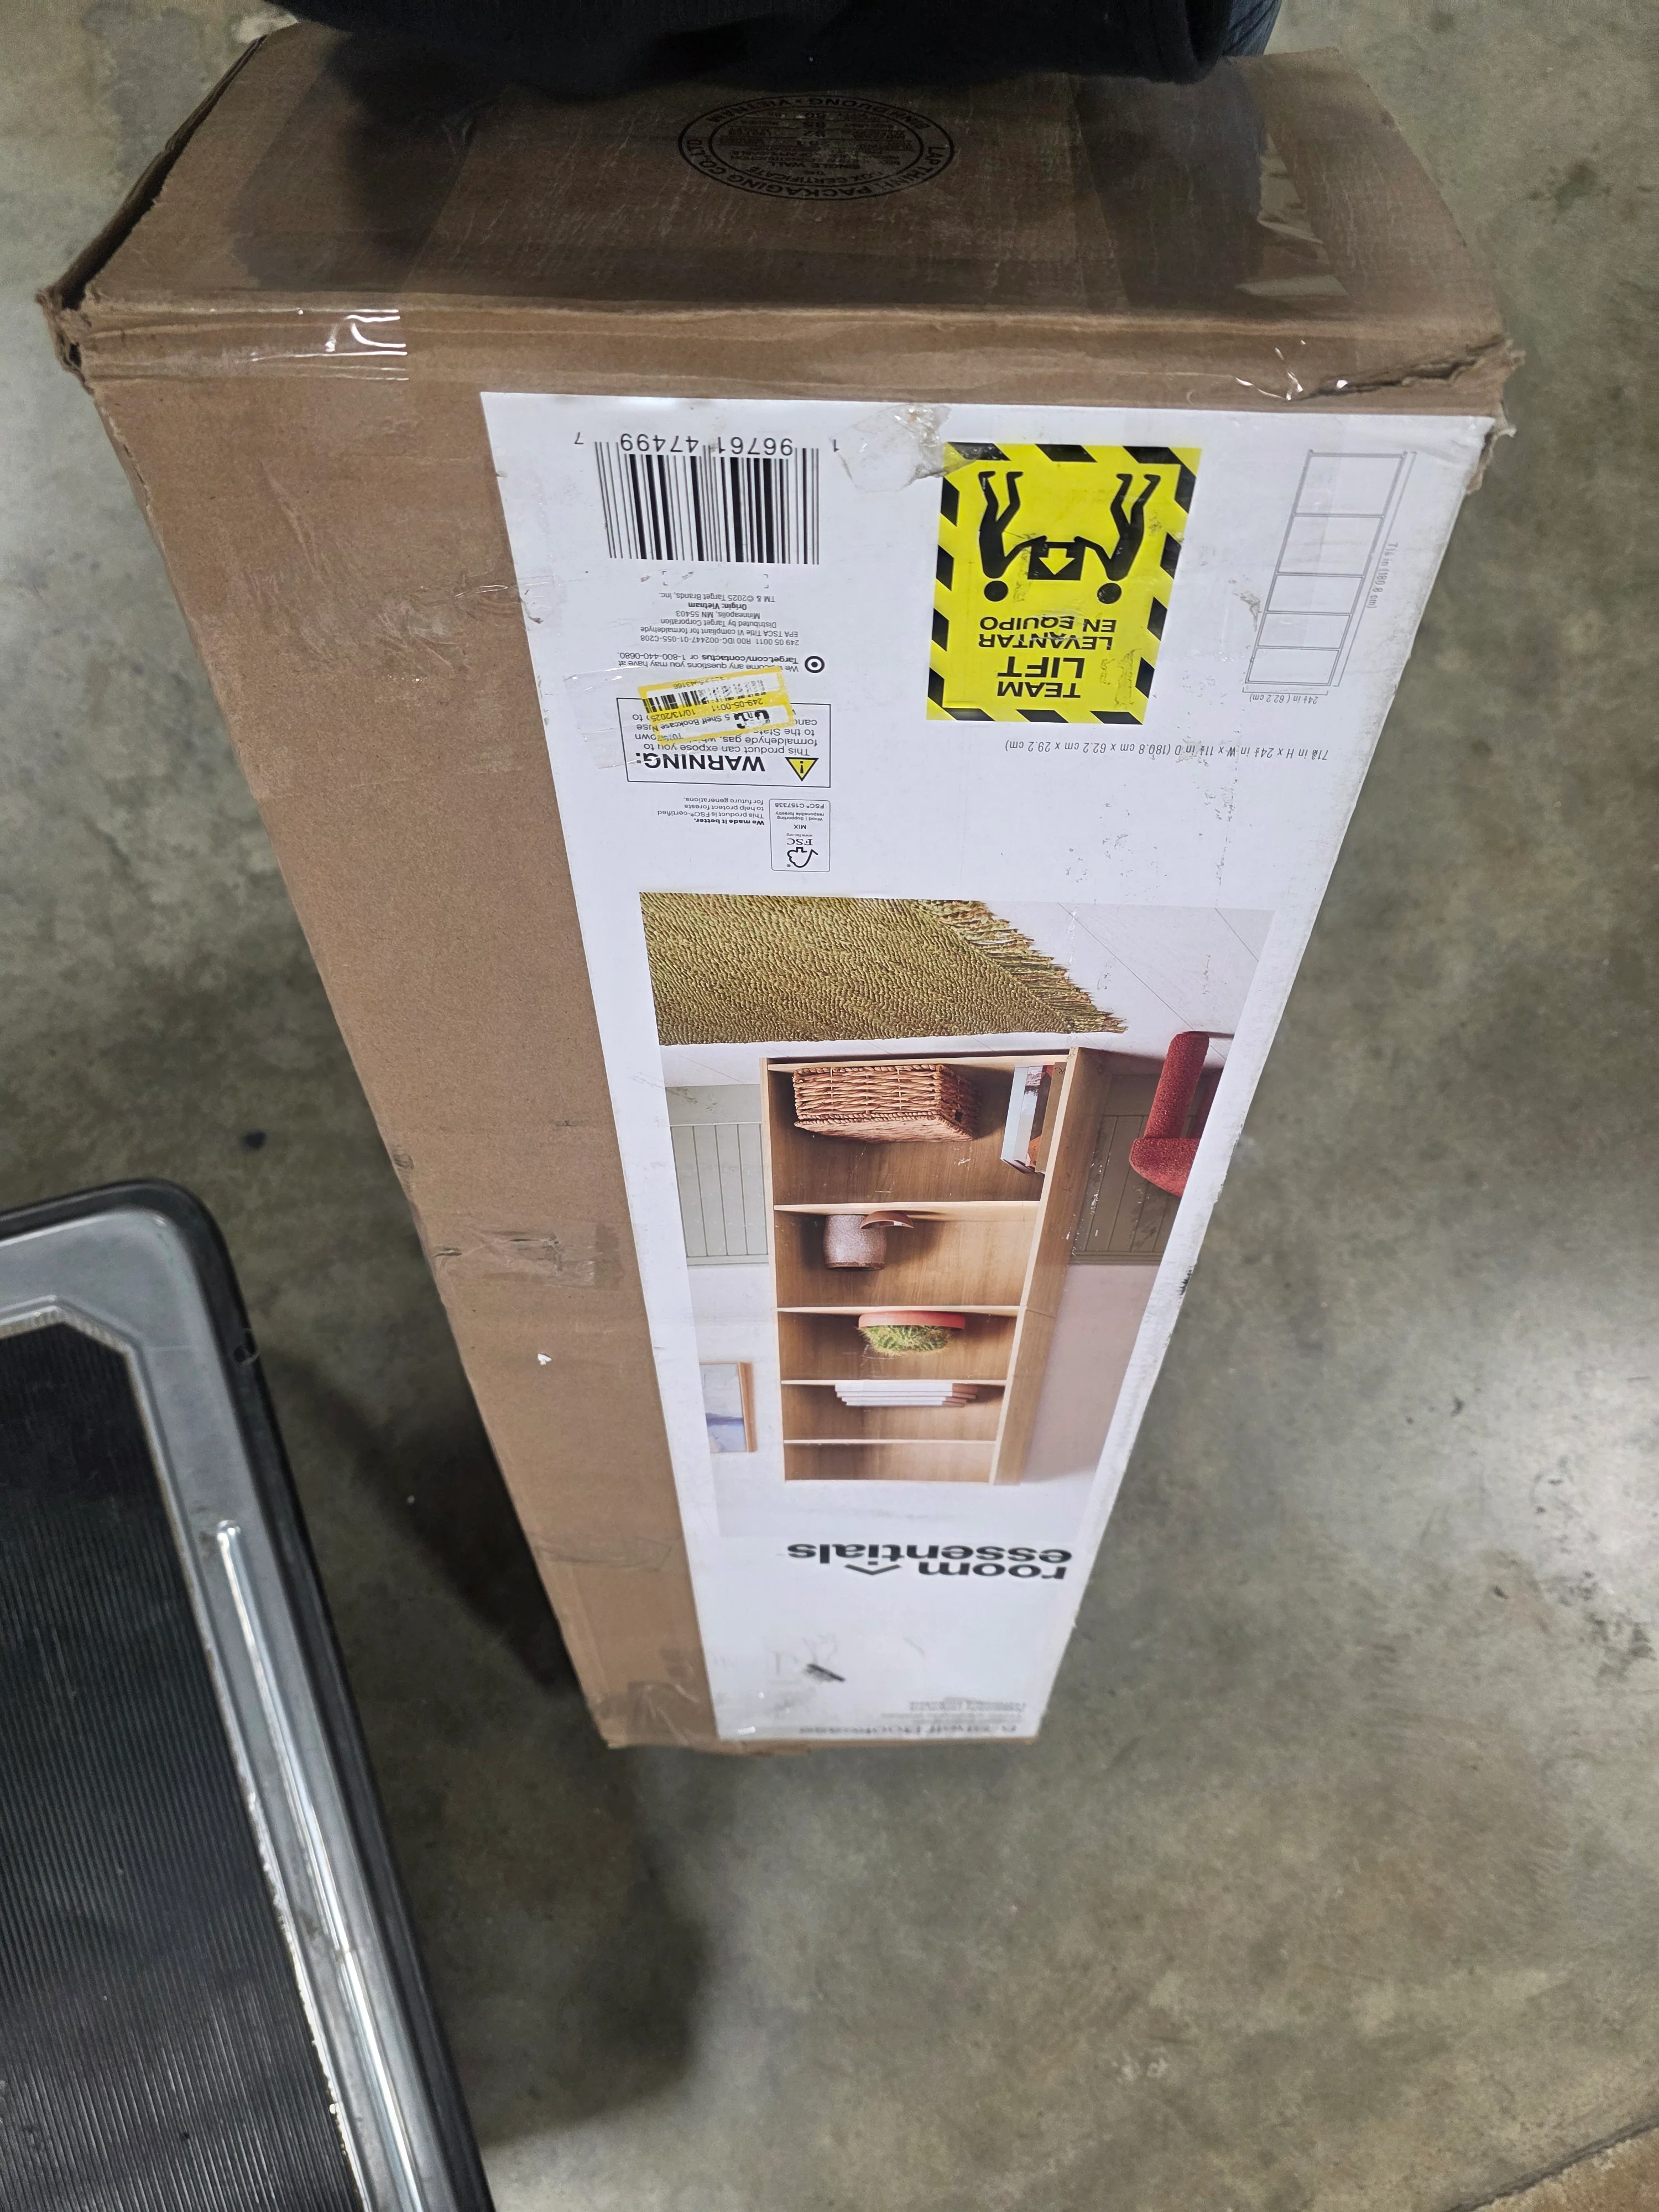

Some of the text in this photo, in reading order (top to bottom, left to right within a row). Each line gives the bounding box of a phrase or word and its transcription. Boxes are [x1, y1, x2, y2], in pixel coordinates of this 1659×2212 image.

[745, 165, 848, 184] CERTIFICATE
[726, 174, 873, 197] PACKAGING
[573, 431, 839, 457] 1 96761 47499 7
[674, 592, 702, 600] Brands,
[703, 592, 726, 601] Target
[721, 602, 747, 611] Origin:
[715, 611, 760, 619] Minneapolis,
[979, 615, 1074, 631] EQUIPO
[1082, 618, 1117, 633] EN
[640, 635, 735, 644] IDC-002447-01-055-C208
[978, 632, 1113, 651] LEVANTAR
[617, 652, 686, 661] 1-800-440-0680.
[701, 655, 799, 664] Target.com/contactus
[997, 656, 1085, 679] LIFT
[997, 681, 1081, 698] TEAM
[1249, 693, 1264, 703] cm)
[1266, 694, 1285, 703] 62.2
[1293, 695, 1301, 704] in
[650, 708, 696, 722] 10/13/2025
[702, 715, 722, 725] Shelf
[660, 718, 700, 729] Bookcase
[784, 728, 801, 737] the
[745, 735, 817, 747] formaldehyde
[1005, 740, 1024, 752] cm)
[1055, 742, 1061, 750] x
[680, 743, 718, 752] expose
[744, 746, 785, 755] product
[1027, 741, 1051, 753] 29.2
[1065, 742, 1079, 751] cm
[1083, 742, 1107, 754] 62.2
[1120, 743, 1135, 753] cm
[1138, 743, 1171, 756] (180.8
[1174, 745, 1182, 755] D
[1186, 745, 1196, 756] in
[788, 748, 810, 756] This
[1225, 747, 1236, 757] W
[1240, 747, 1250, 757] in
[1277, 748, 1284, 756] x
[1286, 748, 1295, 759] H
[1298, 748, 1308, 759] in
[635, 753, 765, 772] WARNING:
[786, 1543, 1072, 1566] essentials
[917, 1561, 1067, 1580] room
